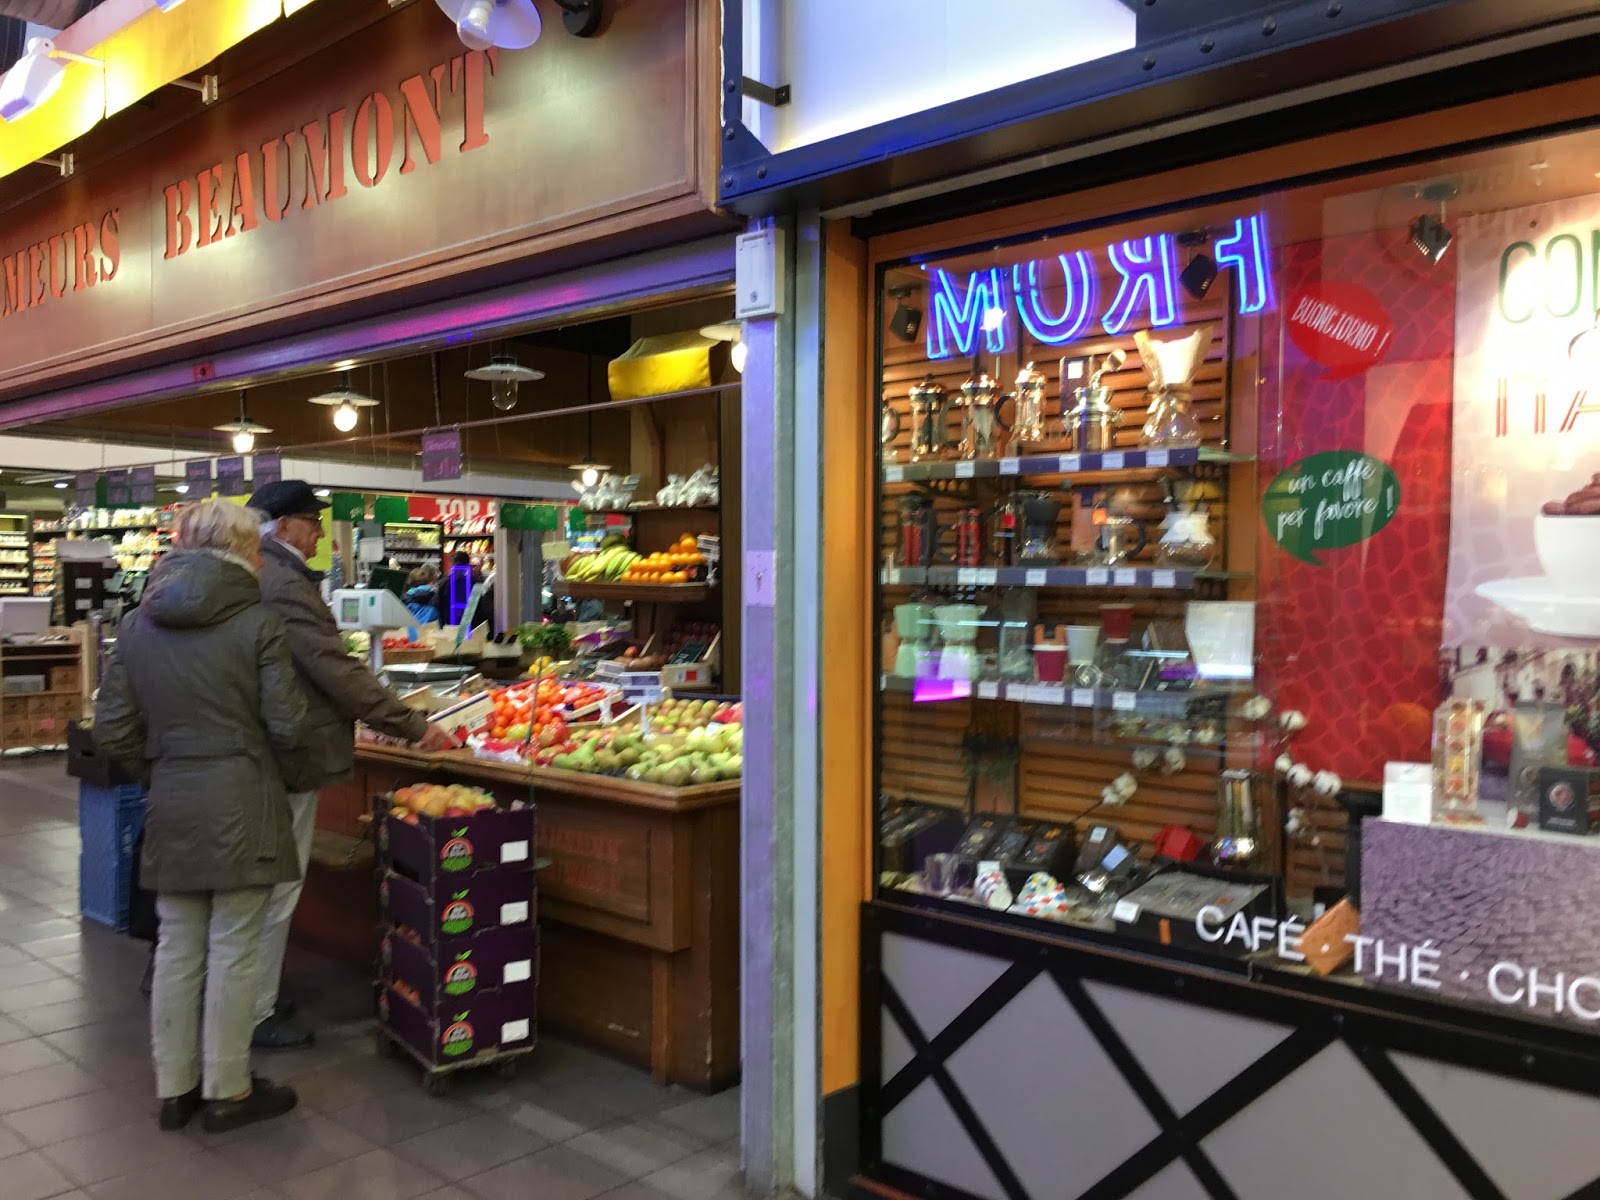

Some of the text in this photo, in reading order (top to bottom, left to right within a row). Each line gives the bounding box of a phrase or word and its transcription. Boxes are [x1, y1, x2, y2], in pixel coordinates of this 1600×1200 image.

[2, 46, 497, 317] MEURS BEAUMONT
[1291, 297, 1378, 351] BUONGIORNO
[1288, 475, 1317, 494] un
[436, 498, 480, 524] TOP
[1277, 507, 1308, 541] per
[1314, 498, 1379, 540] favore
[1195, 904, 1600, 1021] CAFÉ THÉ CHO
